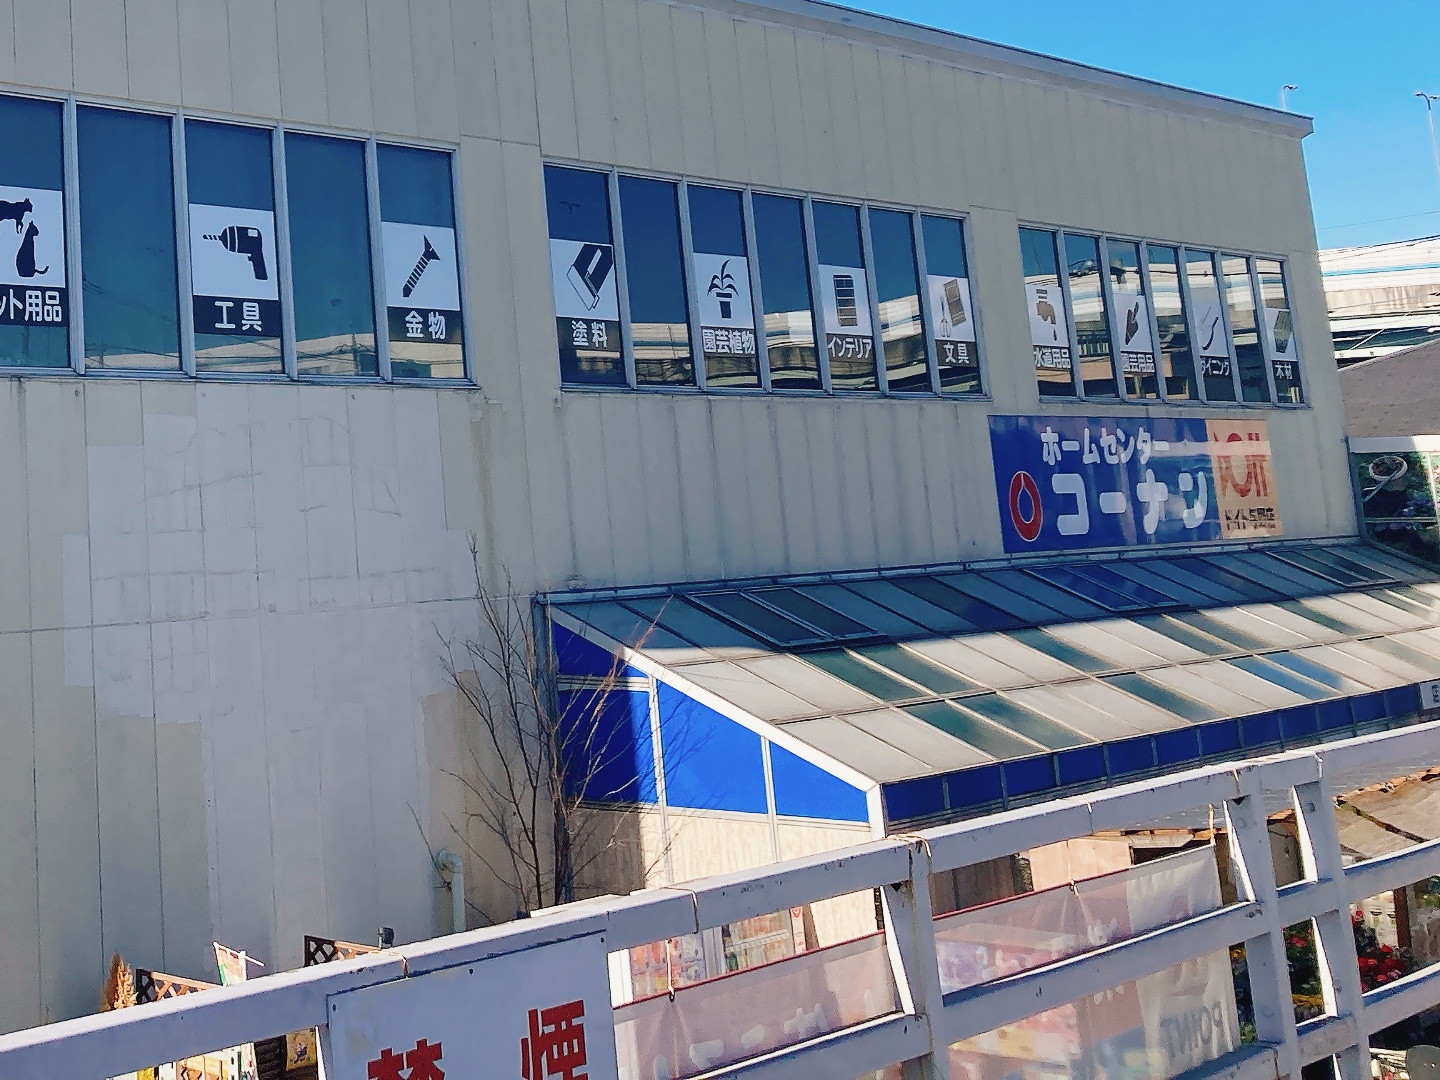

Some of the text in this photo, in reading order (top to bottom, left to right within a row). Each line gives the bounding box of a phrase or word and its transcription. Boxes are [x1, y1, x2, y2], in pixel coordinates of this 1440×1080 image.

[215, 301, 262, 331] 工具
[405, 311, 446, 339] 金物
[572, 320, 607, 348] 塗料
[702, 329, 755, 354] 園芸植物
[828, 337, 872, 358] インテリア
[944, 342, 969, 363] 文具
[1033, 347, 1071, 368] 水道用品
[1041, 426, 1169, 465] ホームセンター
[1052, 469, 1208, 535] コーナン
